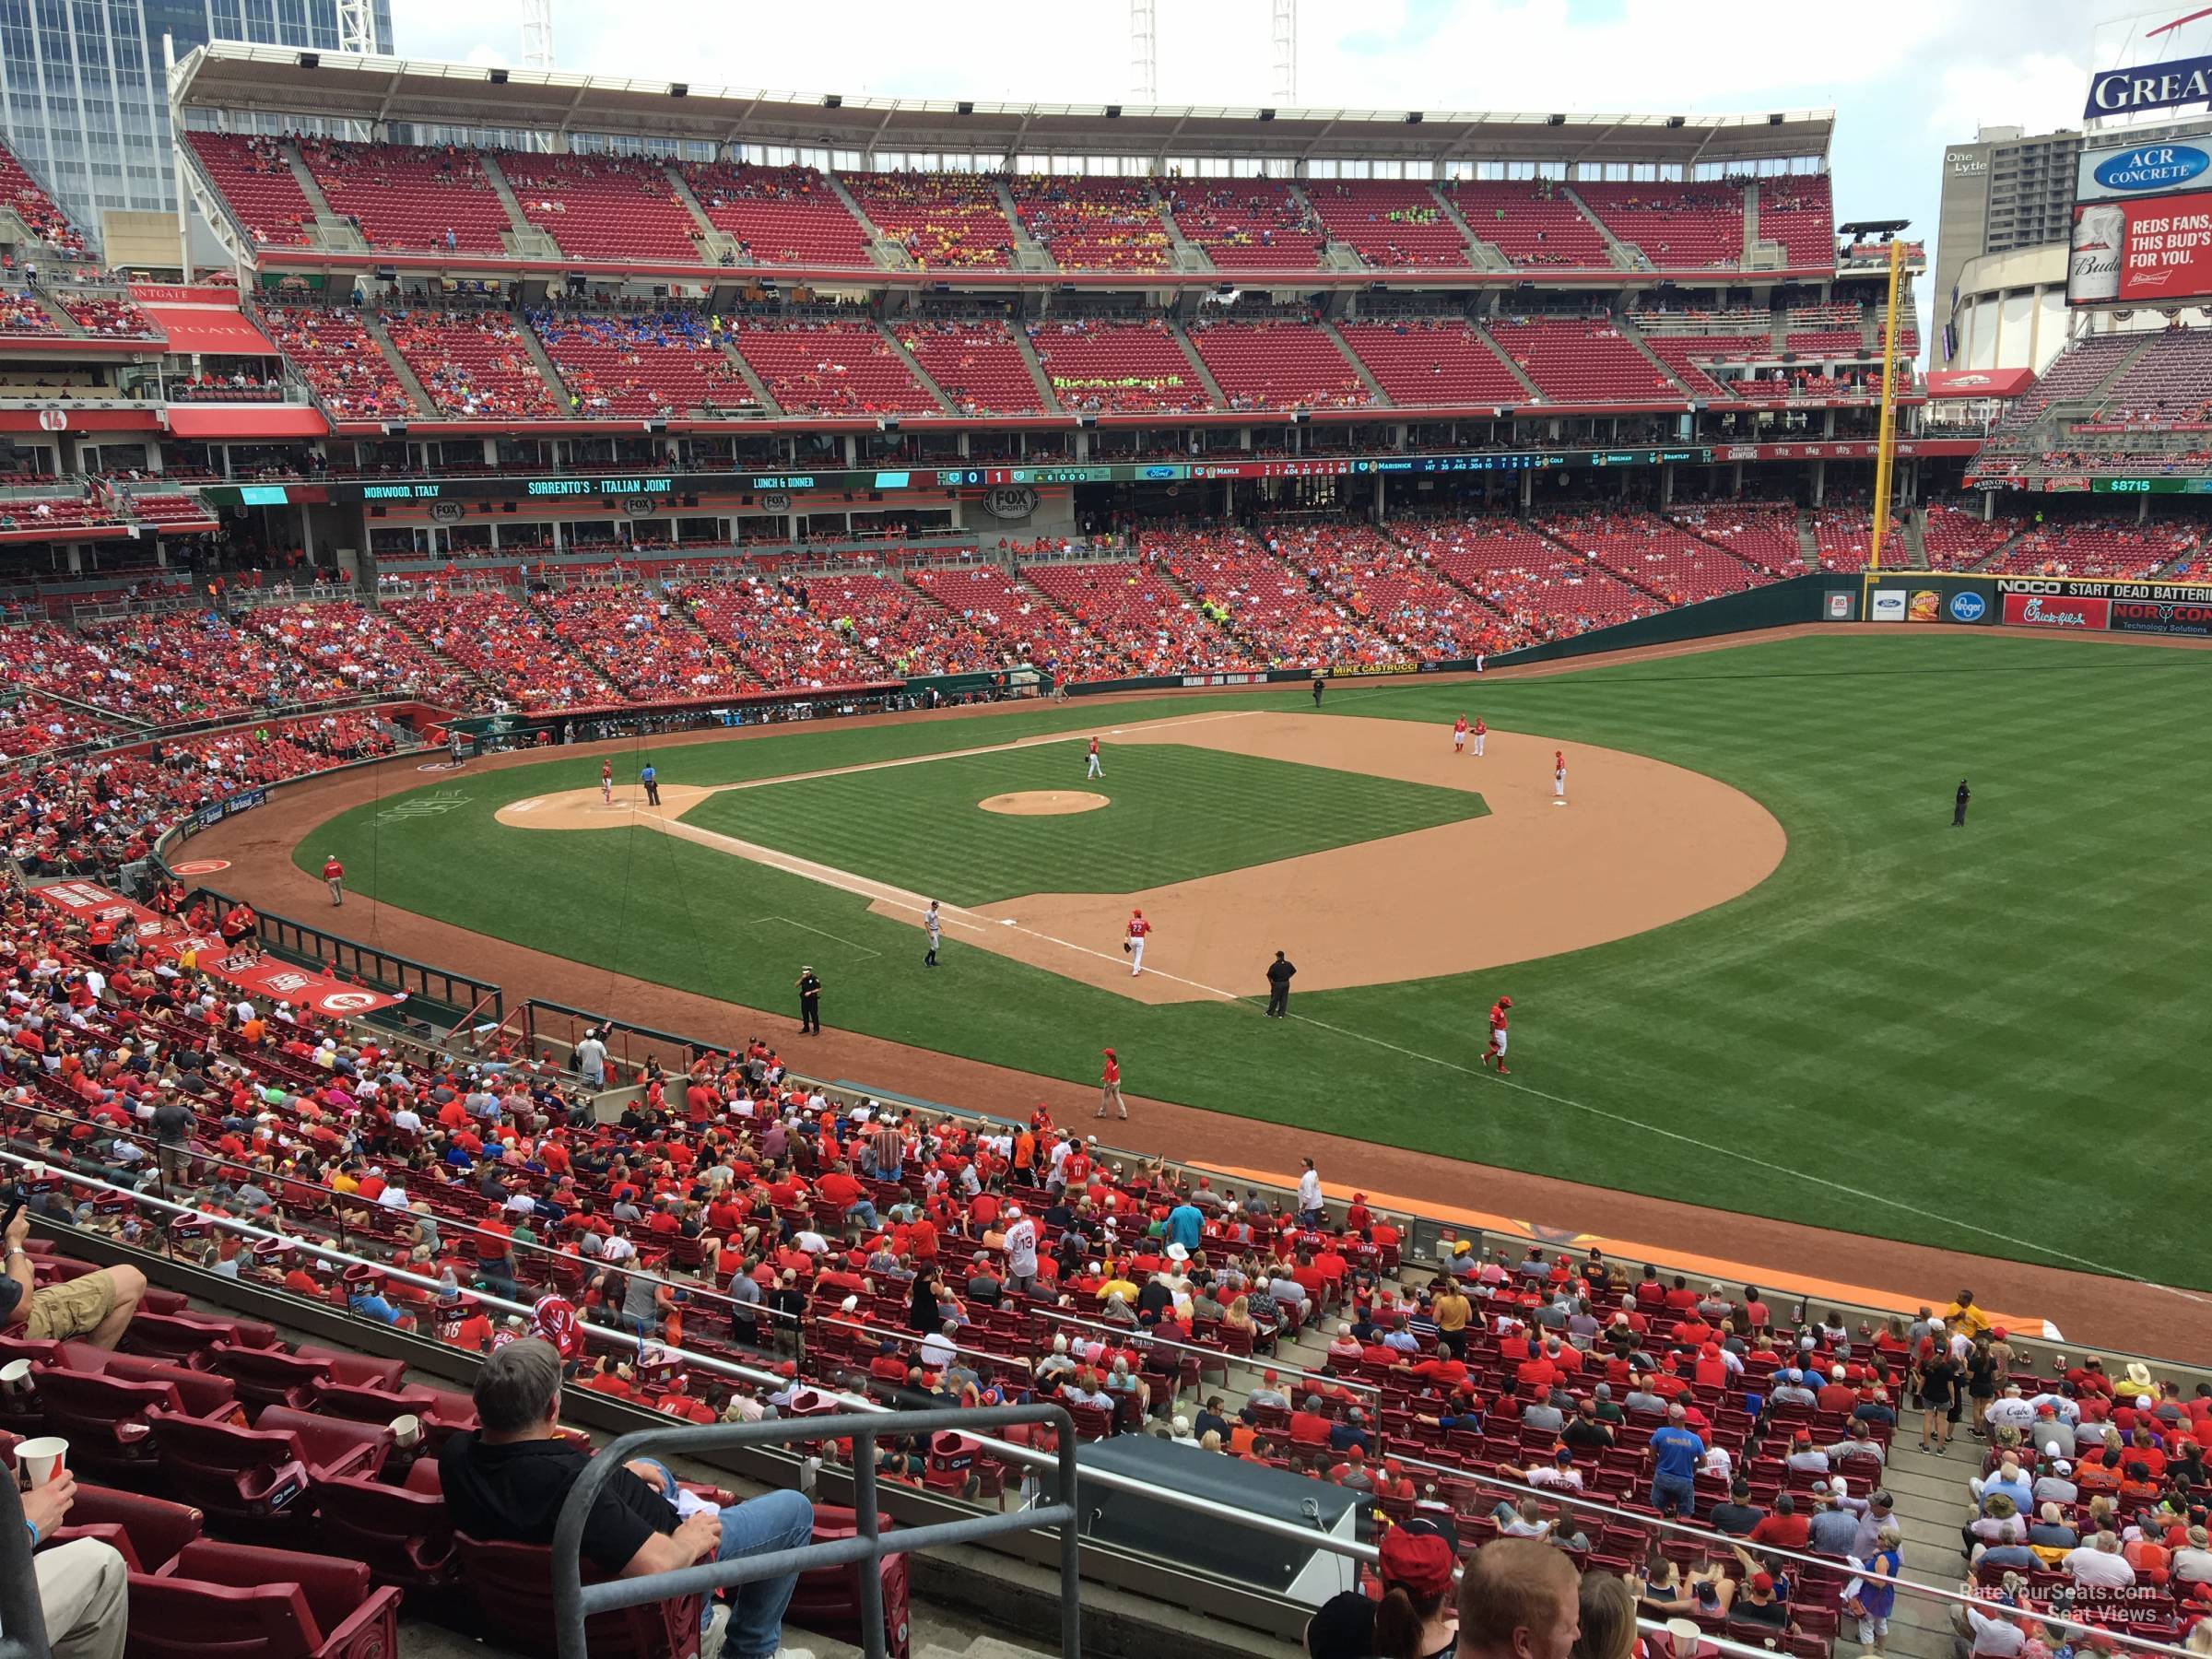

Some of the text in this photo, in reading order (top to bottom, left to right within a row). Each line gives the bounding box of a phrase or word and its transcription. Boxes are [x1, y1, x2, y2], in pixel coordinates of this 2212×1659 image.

[1947, 153, 1973, 162] One
[2128, 148, 2174, 169] ACR
[1955, 161, 1988, 172] Lytle
[2109, 165, 2190, 184] CONCRETE
[2132, 218, 2170, 235] REDS
[2131, 231, 2212, 252] THIS BUD'S
[2129, 250, 2194, 268] FOR YOU.
[169, 325, 253, 335] TGATE
[43, 411, 64, 429] 14
[1728, 449, 1759, 459] CHAMPIONS
[754, 478, 777, 488] LUNCH
[788, 477, 814, 488] DINNER
[968, 472, 978, 483] 0
[995, 472, 1002, 483] 1
[1973, 479, 1994, 488] QUEEN
[528, 481, 590, 495] SORRENTO'S
[601, 480, 641, 493] ITALIAN
[644, 479, 671, 492] JOINT
[2111, 480, 2150, 491] $8715
[364, 486, 439, 499] NORWOOD, ITALY
[995, 489, 1027, 505] FOX
[629, 499, 649, 508] FOX
[767, 495, 784, 504] FOX
[436, 505, 456, 514] FOX
[1998, 580, 2061, 594] NOCO
[2069, 582, 2110, 596] START
[2114, 584, 2148, 598] DEAD
[1835, 598, 1844, 606] 20
[1912, 595, 1939, 606] Kahn's
[1955, 597, 1981, 617] Kroger
[2124, 621, 2207, 634] Technology Solutions
[1334, 665, 1359, 675] MIKE
[1361, 664, 1418, 673] CASTRUCCI
[230, 795, 252, 812] Barbasol
[266, 973, 306, 991] 1990
[1206, 1226, 1217, 1235] 14
[1020, 1236, 1032, 1250] 13
[1300, 1235, 1320, 1243] LARKIN
[603, 1245, 616, 1260] 21
